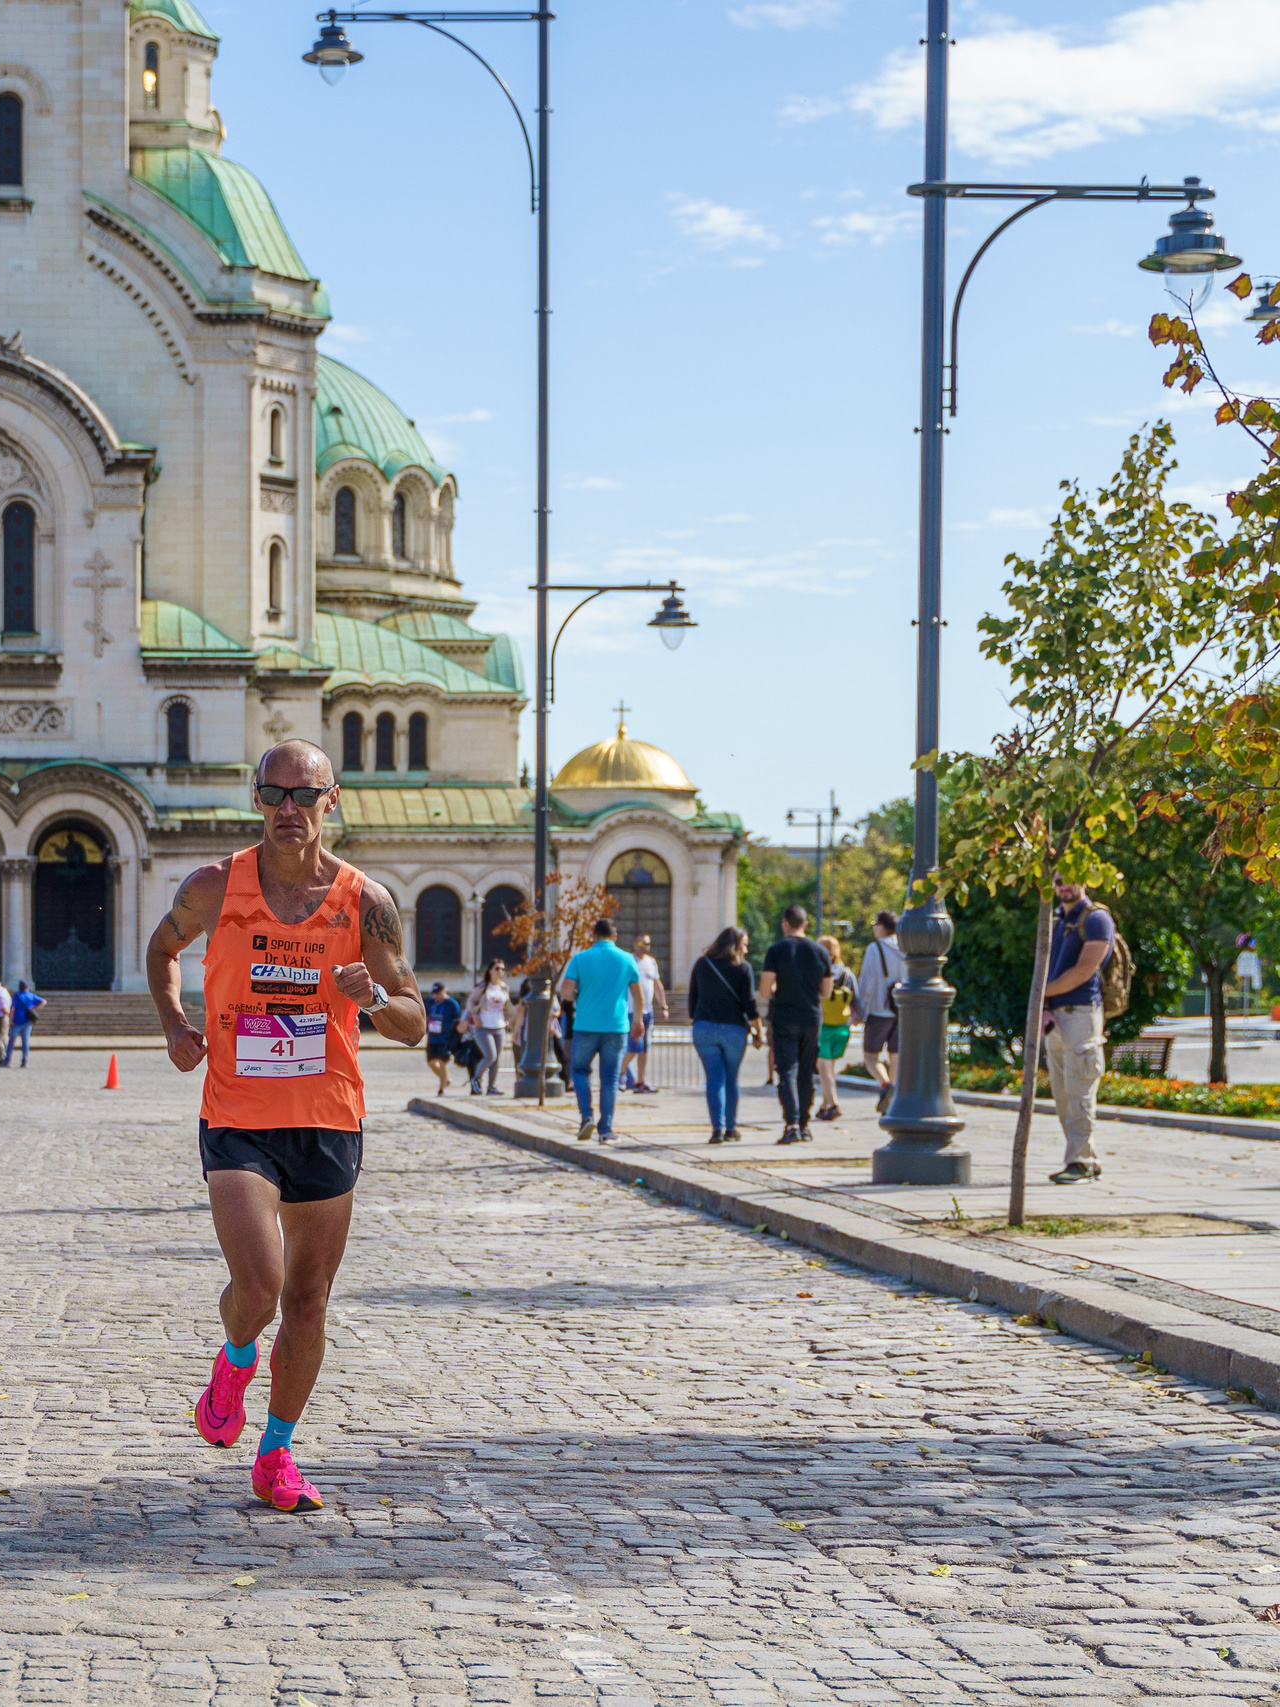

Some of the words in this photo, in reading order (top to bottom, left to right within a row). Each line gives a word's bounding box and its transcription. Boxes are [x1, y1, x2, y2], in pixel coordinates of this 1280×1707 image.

[265, 952, 278, 965] Dr
[283, 954, 311, 968] VAIS
[251, 965, 319, 982] CH-Alpha
[228, 1004, 263, 1012] GARMIN
[270, 1040, 294, 1056] 41
